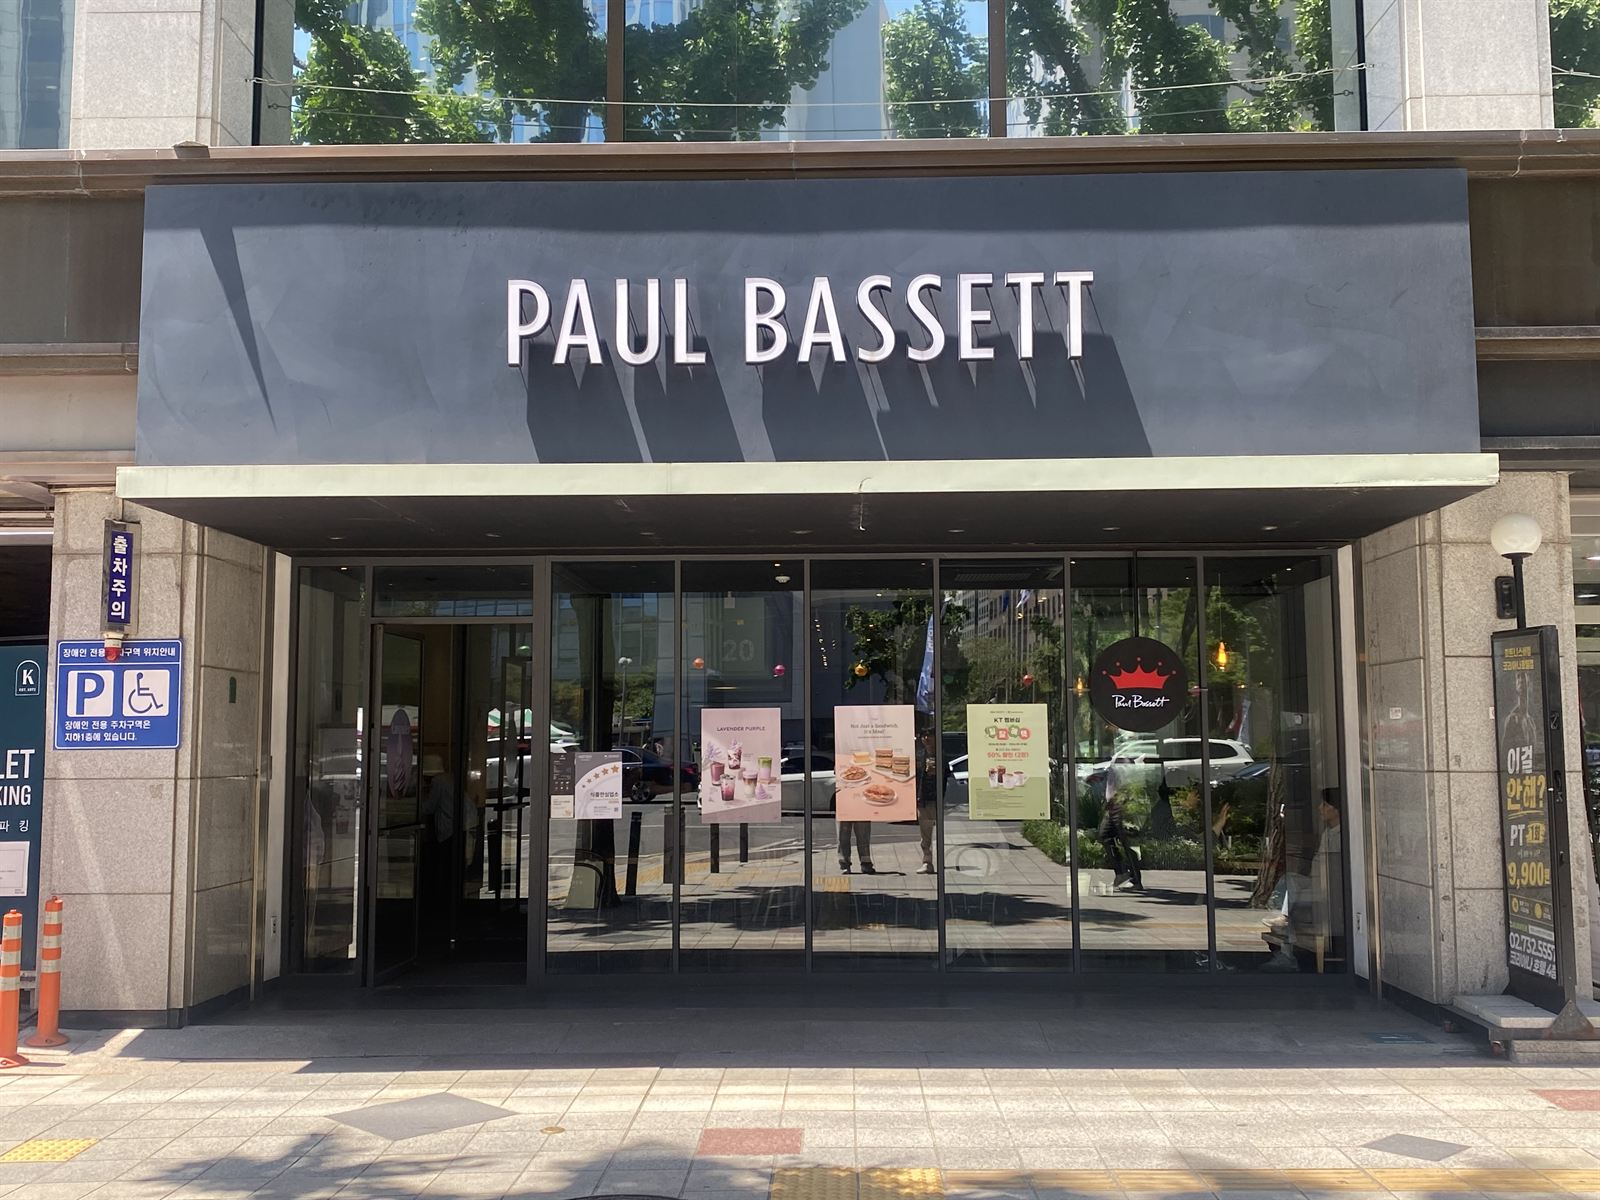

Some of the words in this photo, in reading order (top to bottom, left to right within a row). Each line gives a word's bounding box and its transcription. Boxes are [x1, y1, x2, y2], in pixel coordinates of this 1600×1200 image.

[506, 277, 708, 366] PAUL
[744, 271, 1095, 365] BASSETT
[110, 535, 129, 620] 출차주의
[63, 648, 88, 658] 장애인
[90, 648, 105, 658] 전용
[143, 647, 176, 657] 위치안내
[22, 669, 35, 685] K
[75, 672, 105, 715] P
[1111, 694, 1132, 709] Paul
[1132, 694, 1171, 709] Bassett
[64, 720, 89, 730] 장애인
[91, 720, 107, 730] 전용
[110, 720, 151, 730] 주차구역은
[64, 732, 101, 742] 지하1층에
[103, 732, 138, 742] 있습니다.
[1507, 745, 1533, 774] 이걸
[0, 784, 32, 806] ING
[1506, 774, 1546, 810] 안해?
[1510, 824, 1526, 847] PT
[1508, 861, 1551, 889] 9,900원
[1532, 958, 1547, 976] 호텔
